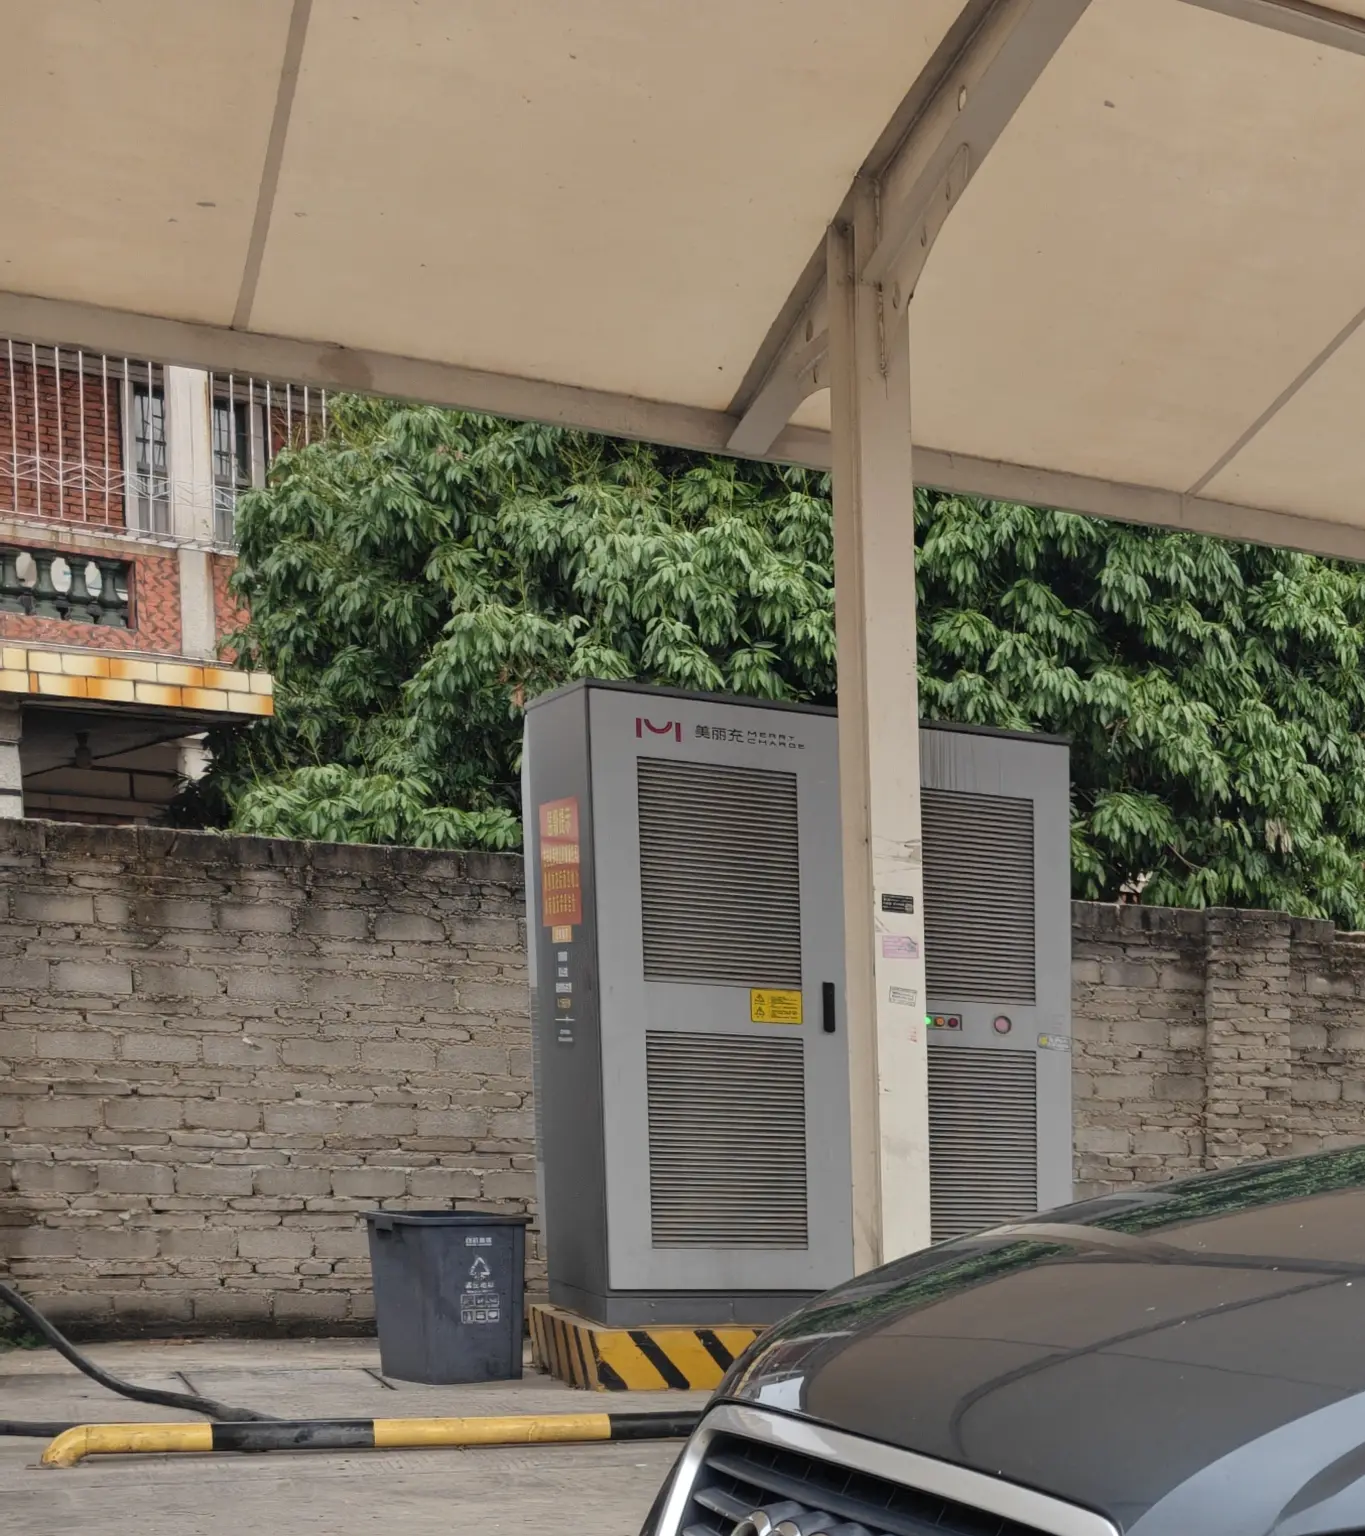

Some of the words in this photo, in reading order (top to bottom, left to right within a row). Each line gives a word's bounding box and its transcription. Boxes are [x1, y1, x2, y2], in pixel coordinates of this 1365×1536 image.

[695, 724, 744, 743] 美丽充
[747, 730, 795, 741] MERRY
[747, 738, 805, 750] CHARGE
